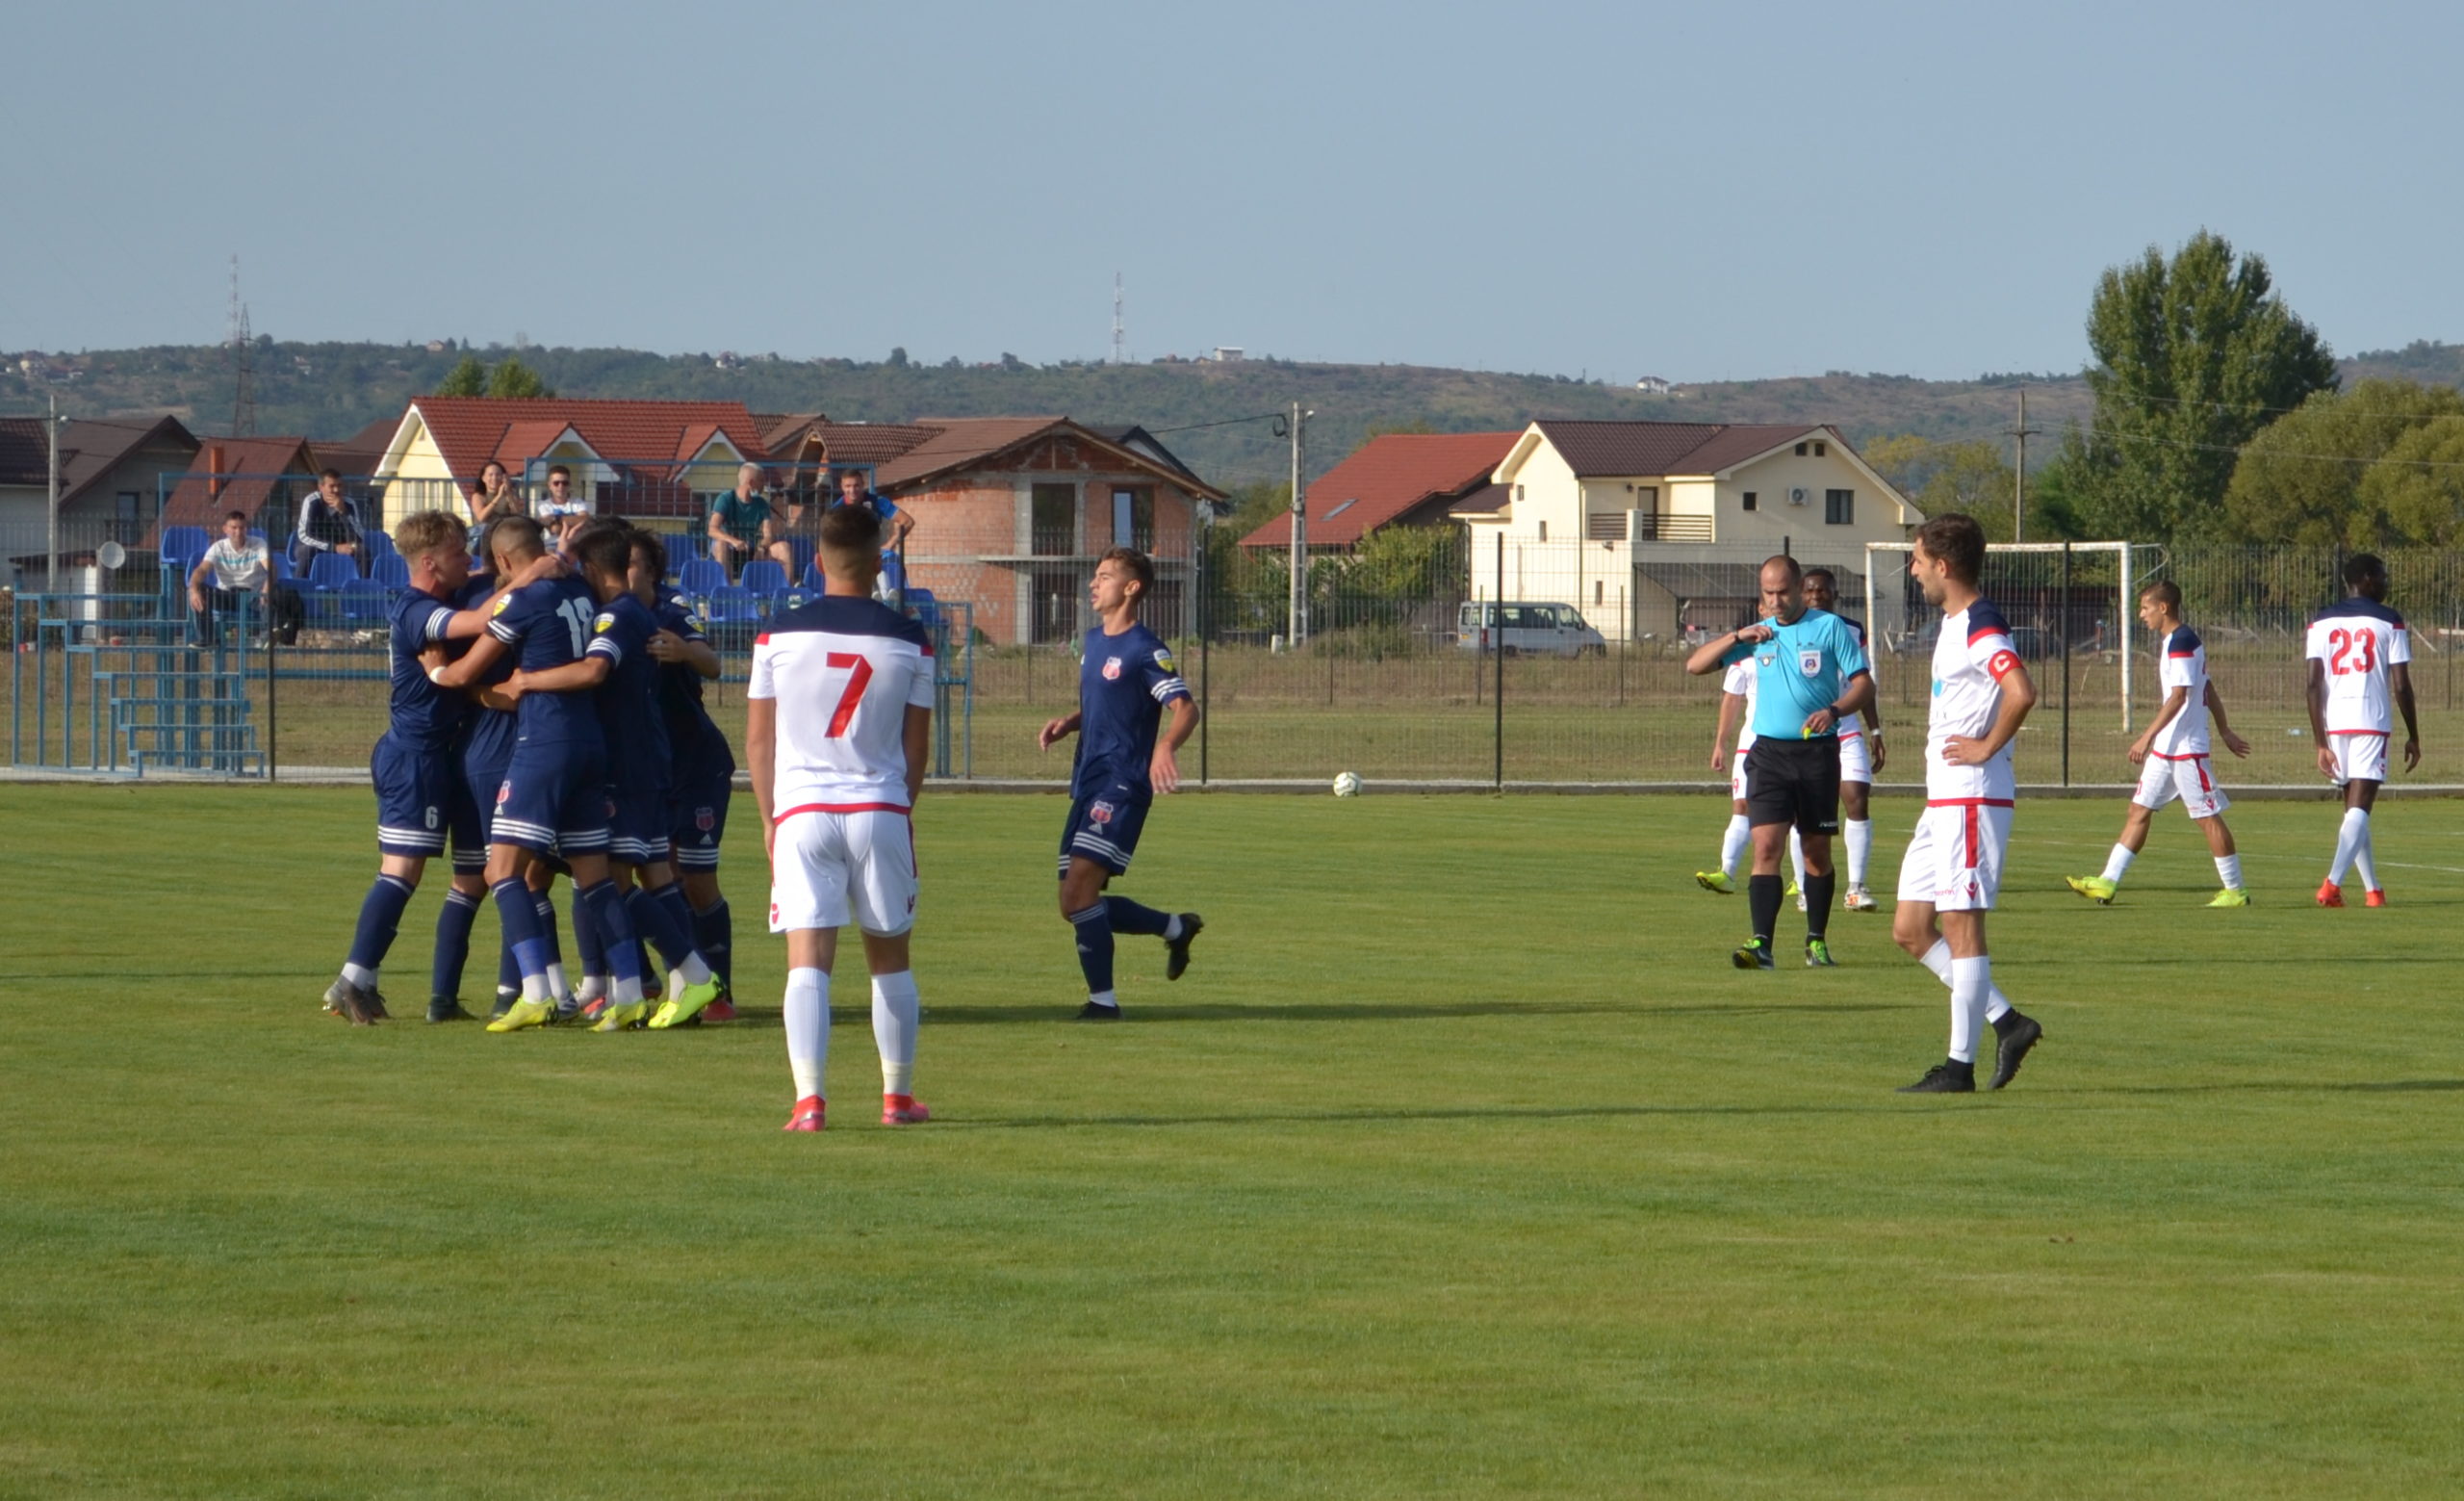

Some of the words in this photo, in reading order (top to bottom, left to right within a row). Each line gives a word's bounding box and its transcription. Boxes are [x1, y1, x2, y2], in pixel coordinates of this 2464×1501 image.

[1993, 654, 2011, 672] C
[2329, 627, 2375, 676] 23
[824, 652, 873, 738] 7
[425, 805, 438, 829] 6
